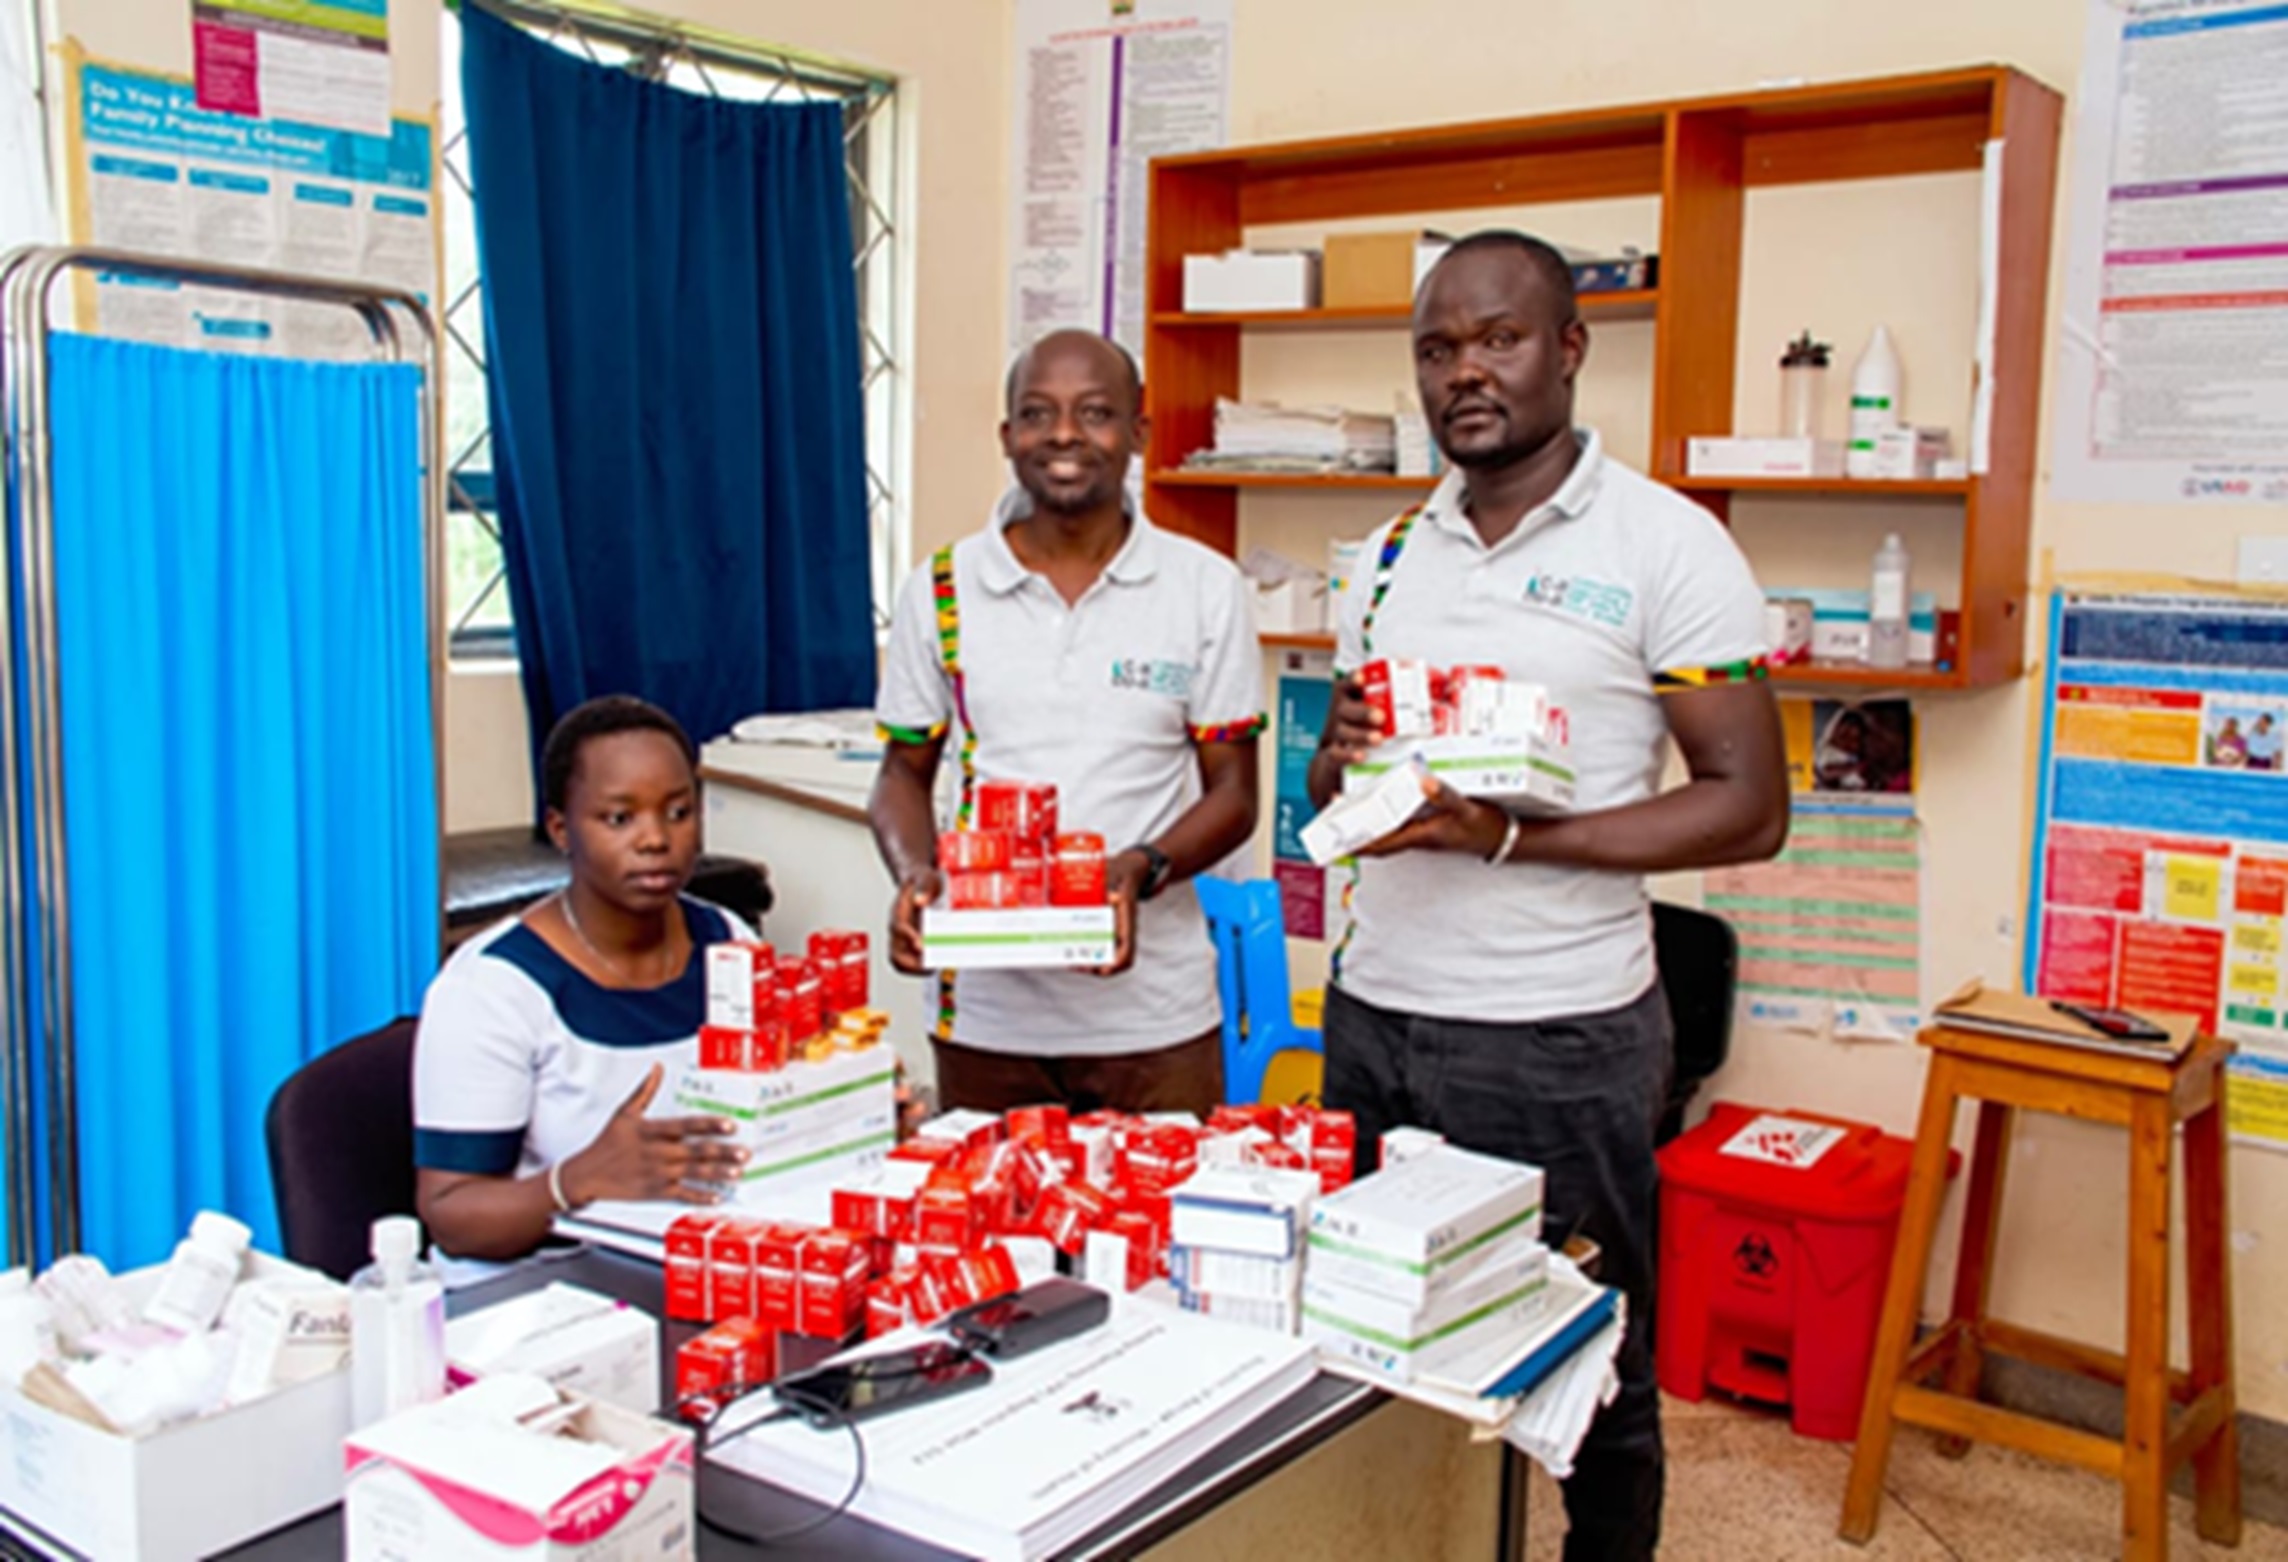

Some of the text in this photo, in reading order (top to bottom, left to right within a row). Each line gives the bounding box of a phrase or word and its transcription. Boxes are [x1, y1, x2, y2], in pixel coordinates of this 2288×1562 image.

[126, 88, 163, 108] You
[91, 101, 158, 130] Family
[164, 114, 248, 146] Planning
